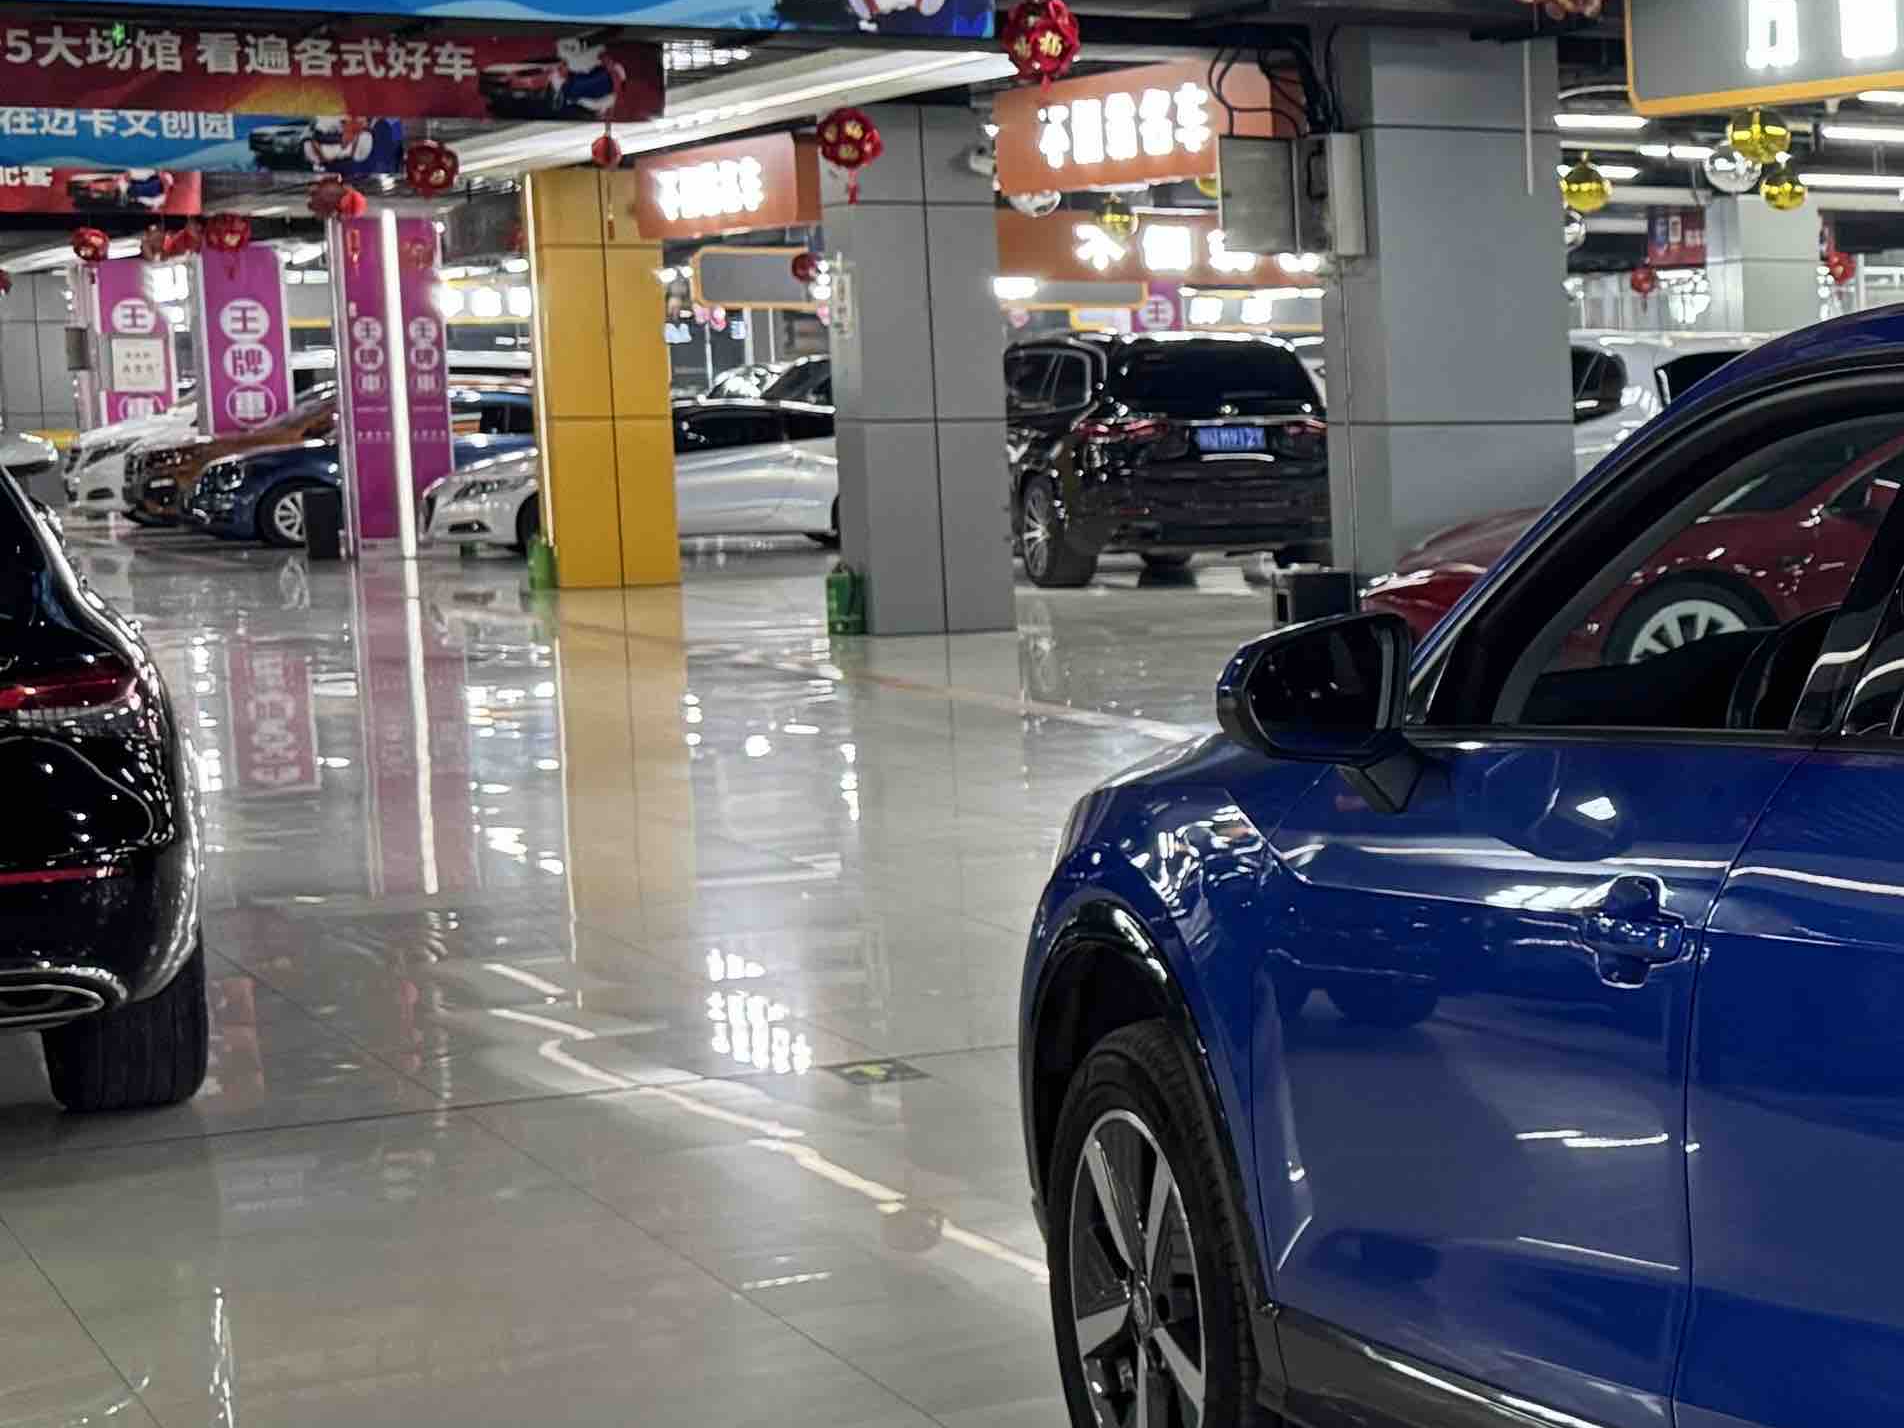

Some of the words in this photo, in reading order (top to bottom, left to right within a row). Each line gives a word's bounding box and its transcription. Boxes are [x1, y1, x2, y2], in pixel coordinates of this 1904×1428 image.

[197, 32, 479, 82] 看遍各式好车
[0, 107, 236, 142] 在迈卡文创园
